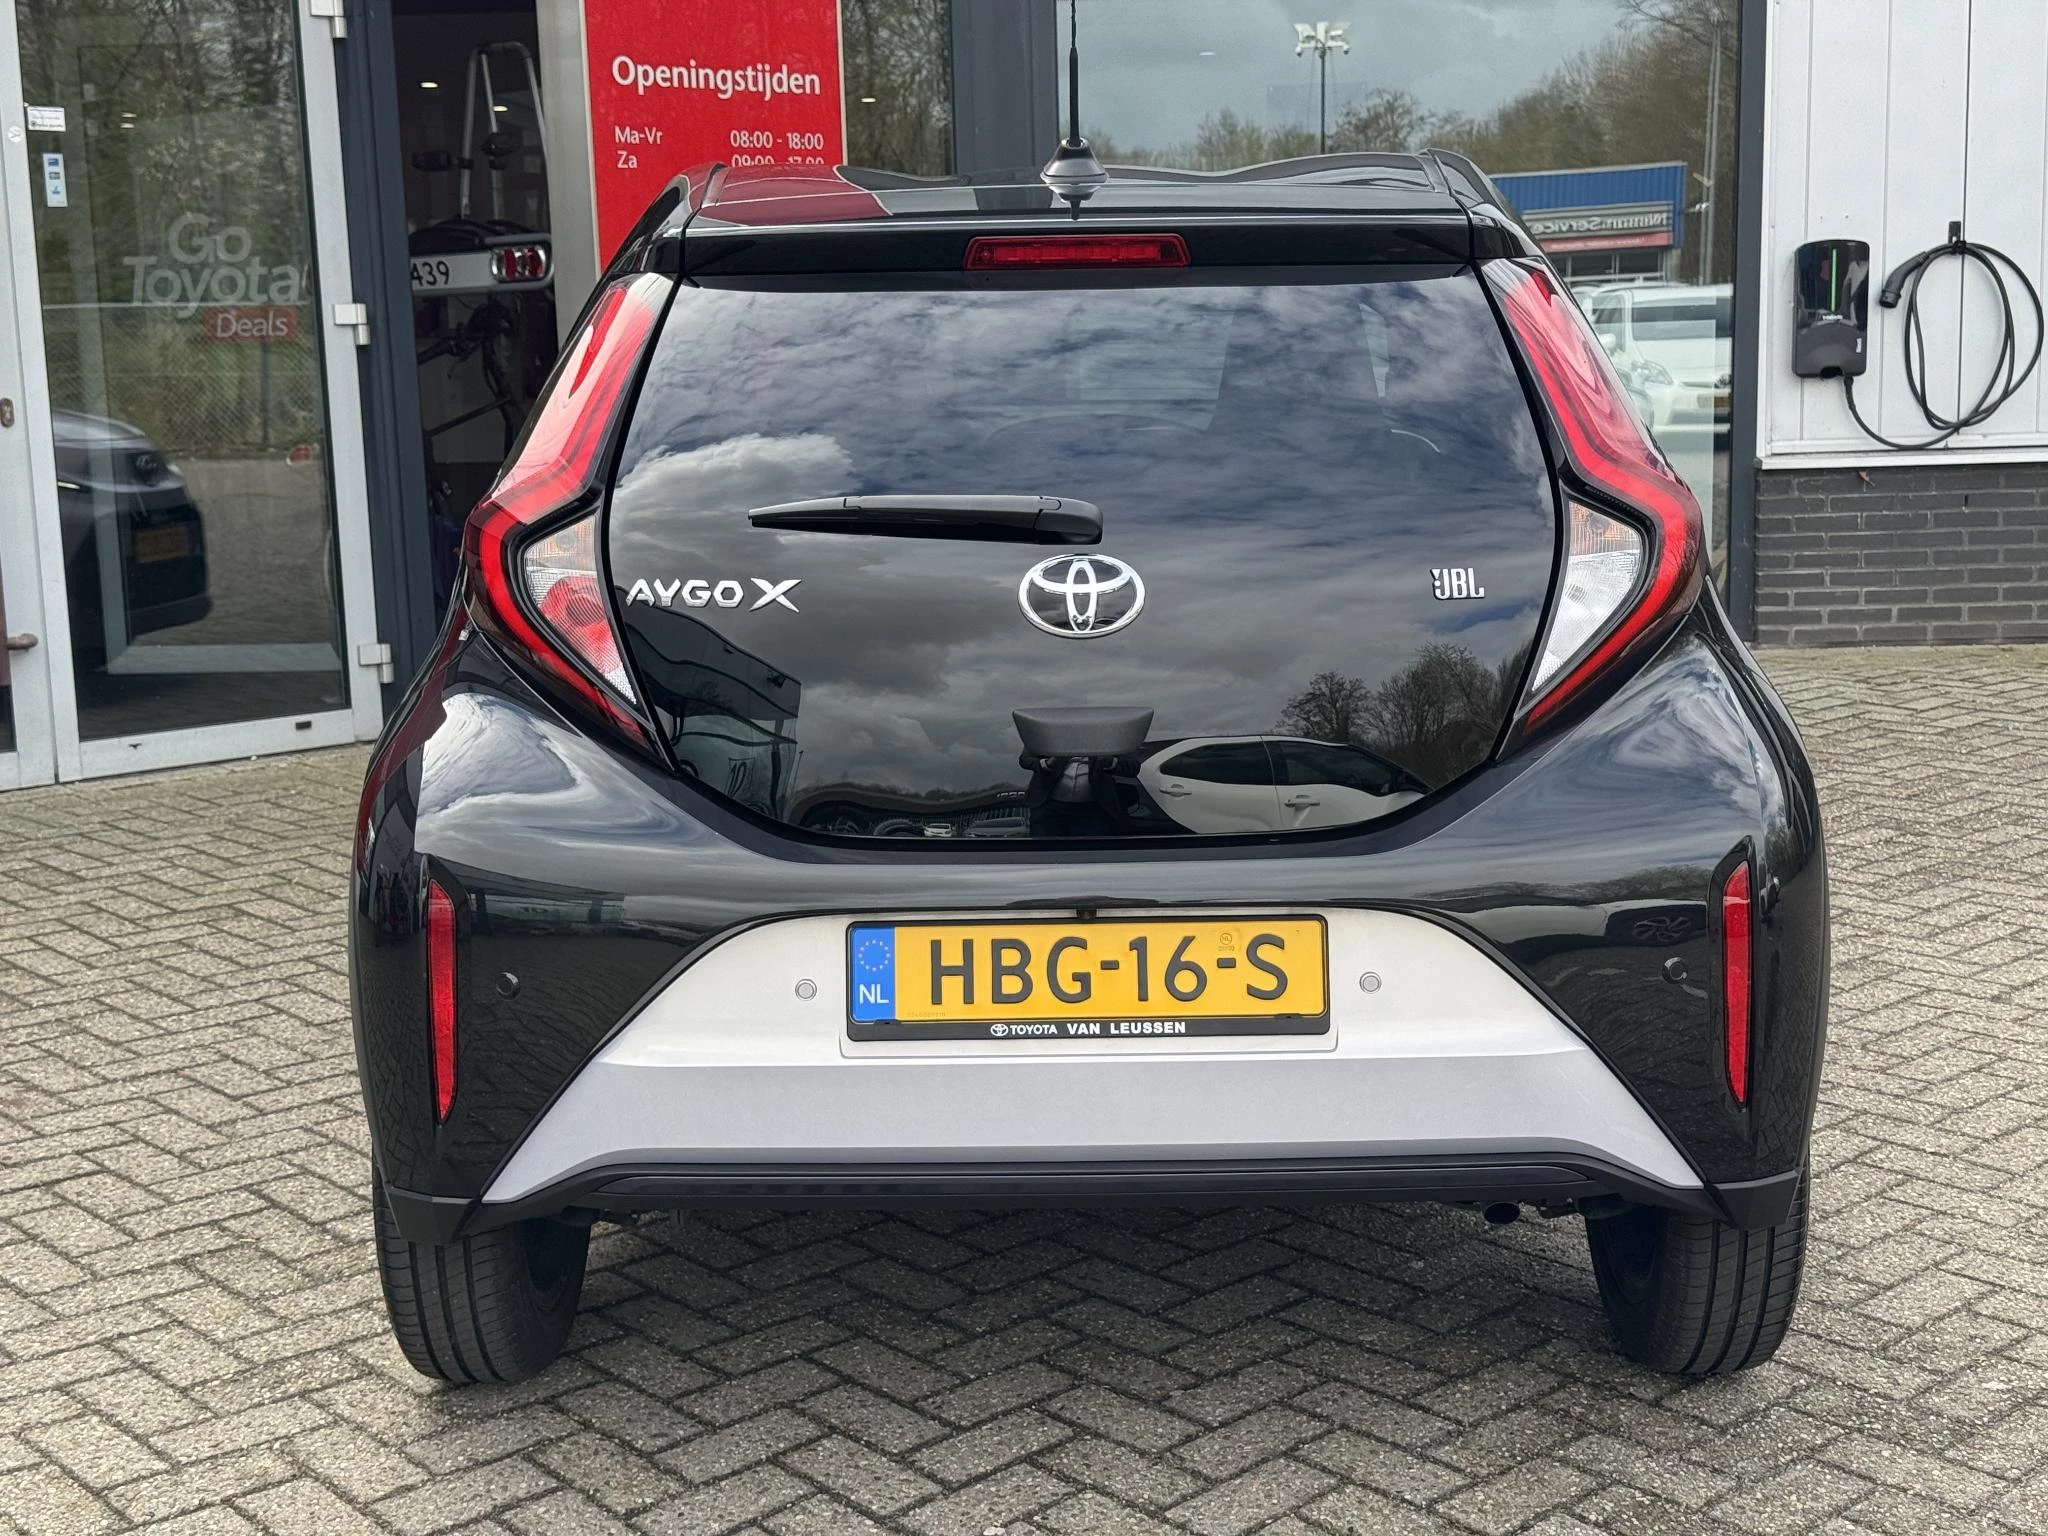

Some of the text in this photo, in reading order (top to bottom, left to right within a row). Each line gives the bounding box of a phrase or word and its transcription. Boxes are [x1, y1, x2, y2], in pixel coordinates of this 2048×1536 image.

[612, 55, 820, 101] Openingstijden
[614, 126, 662, 144] Ma-Vr
[730, 130, 773, 148] 08:00
[786, 132, 824, 150] 18:00
[617, 150, 638, 169] Za
[168, 212, 252, 265] Go
[123, 255, 301, 319] Toyota
[216, 311, 289, 338] Deals
[625, 577, 802, 613] AYGO X
[1430, 567, 1485, 600] JBL
[929, 933, 1289, 1005] HBG-16-S
[859, 983, 890, 1004] NL
[1009, 1021, 1186, 1036] TOYOTA VAN LEUSSEN
